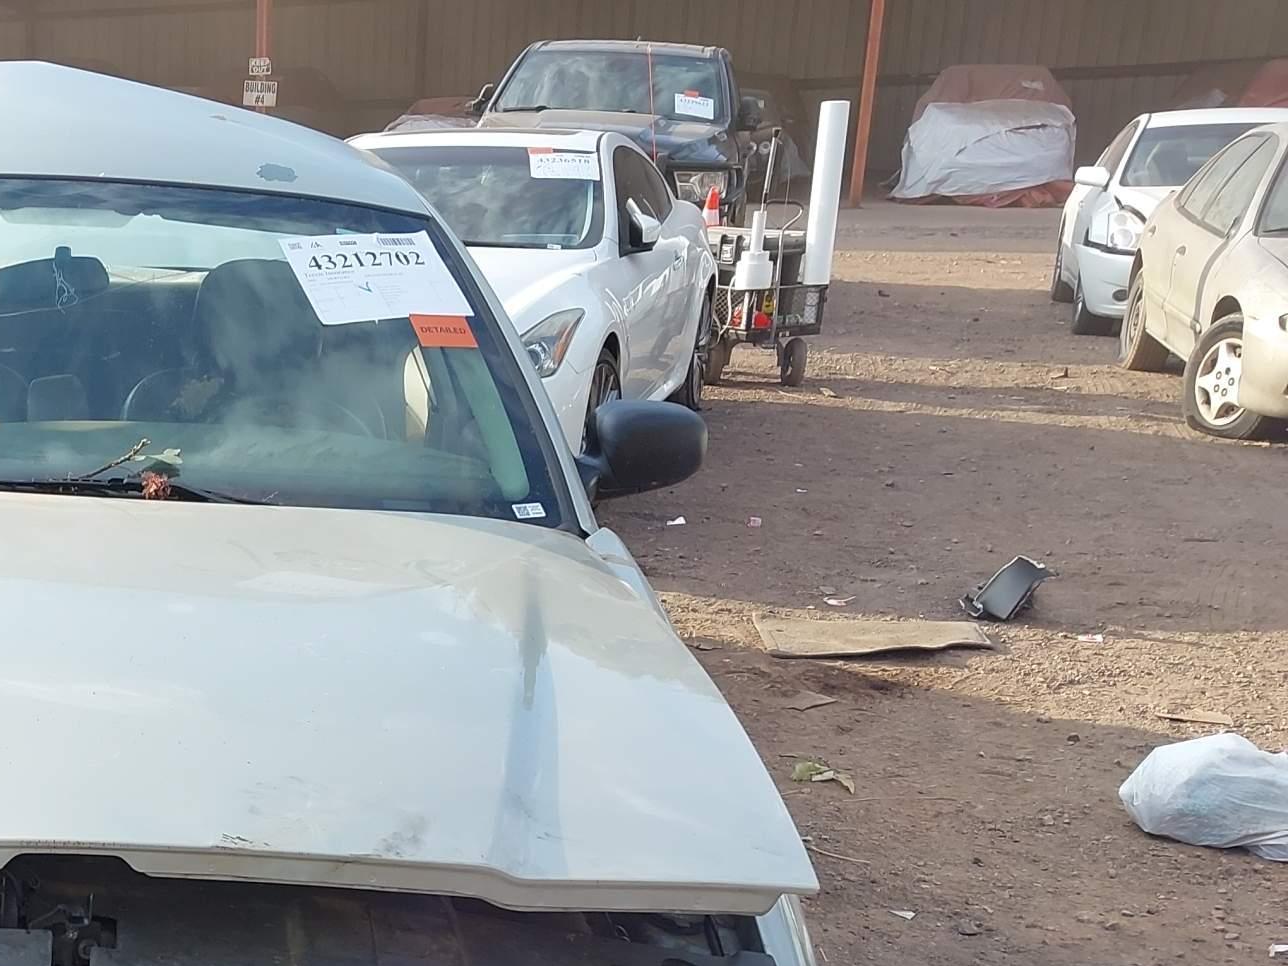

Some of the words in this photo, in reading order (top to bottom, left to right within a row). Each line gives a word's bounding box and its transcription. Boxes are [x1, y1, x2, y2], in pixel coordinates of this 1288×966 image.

[245, 82, 276, 94] BUILDING
[254, 94, 265, 105] #4
[308, 250, 425, 271] 43212702
[420, 326, 466, 335] DETAILED
